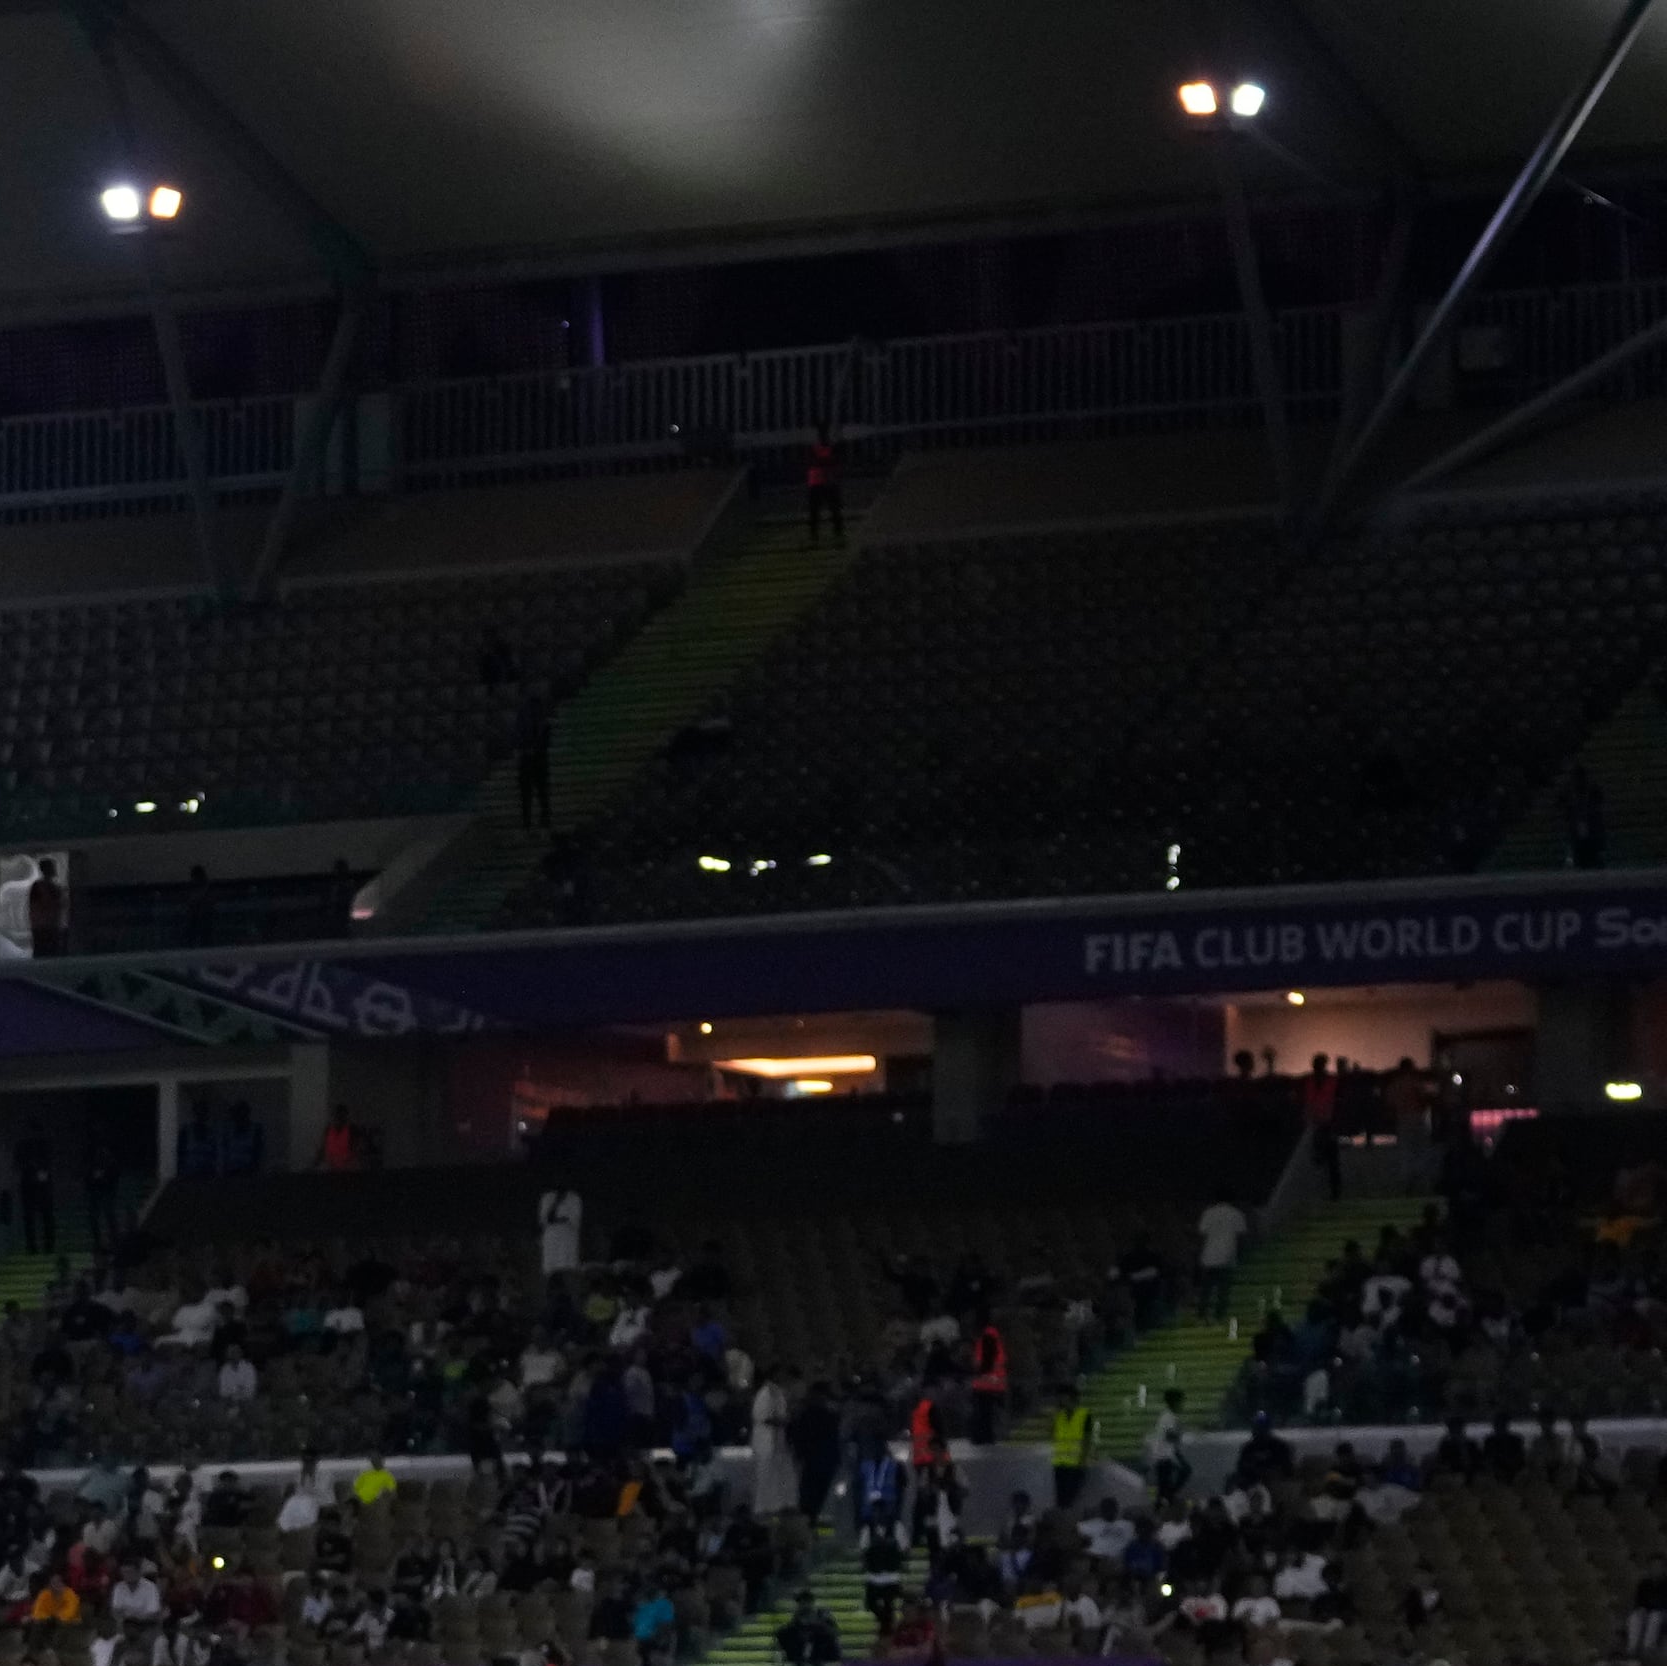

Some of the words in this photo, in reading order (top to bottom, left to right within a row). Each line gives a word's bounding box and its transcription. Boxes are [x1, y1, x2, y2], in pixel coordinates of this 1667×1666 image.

[1085, 933, 1181, 974] FIFA
[1195, 922, 1307, 967] CLUB
[1316, 915, 1481, 961] WORLD
[1492, 908, 1581, 952] CUP
